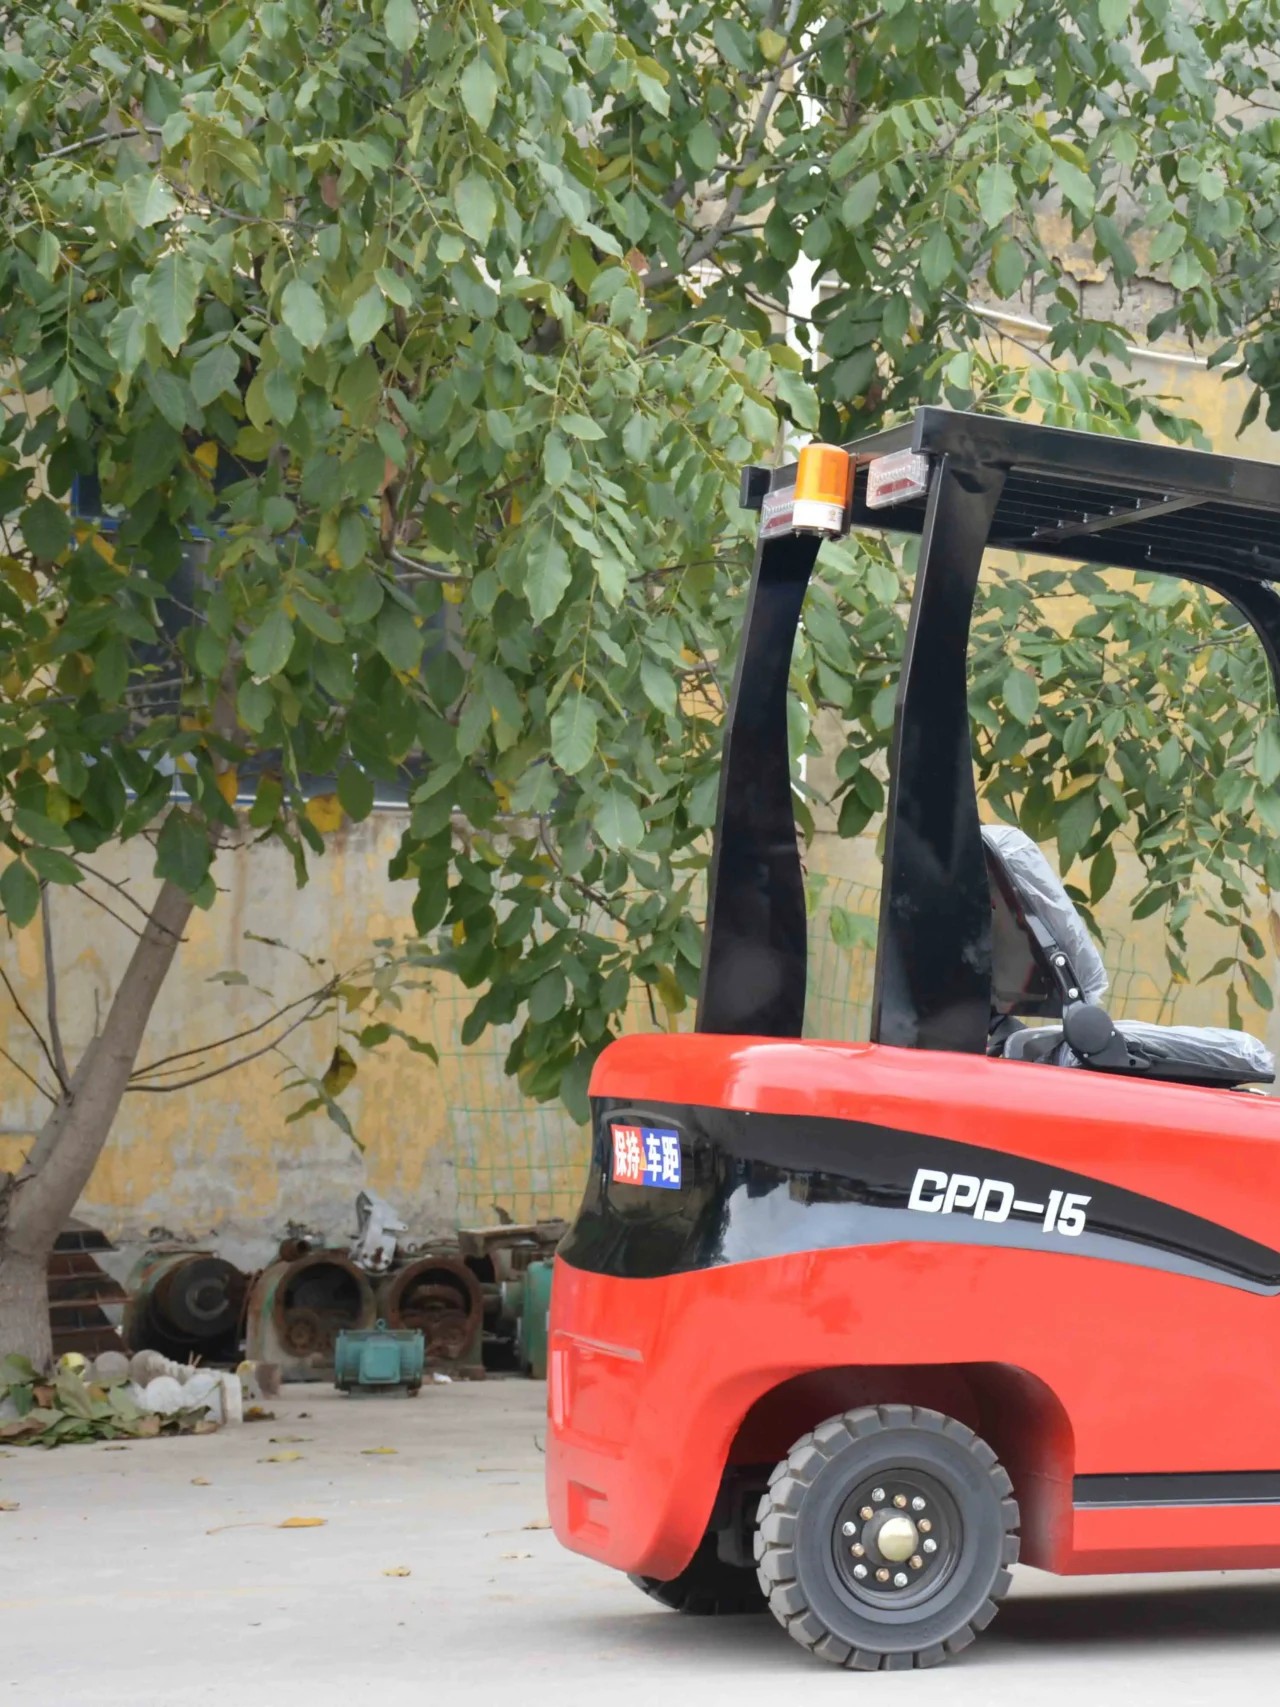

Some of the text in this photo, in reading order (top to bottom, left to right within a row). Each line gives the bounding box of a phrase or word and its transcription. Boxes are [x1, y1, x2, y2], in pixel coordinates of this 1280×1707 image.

[614, 1129, 680, 1183] 保持车距
[908, 1168, 1092, 1237] CPD-15
